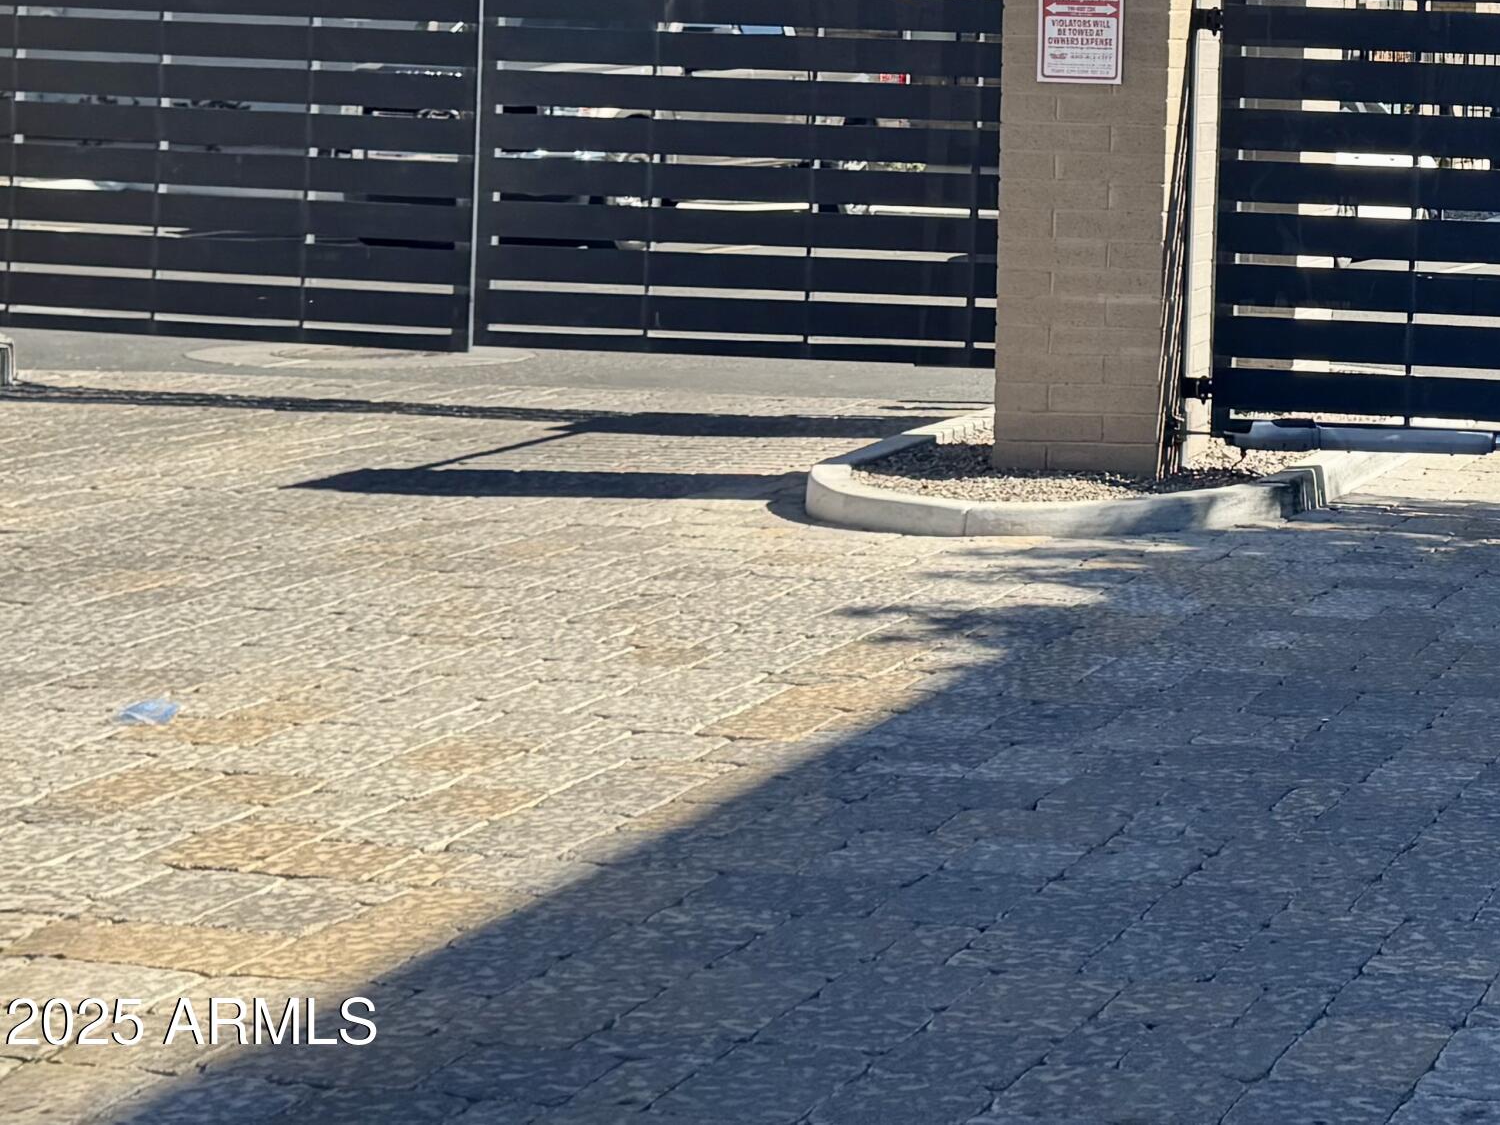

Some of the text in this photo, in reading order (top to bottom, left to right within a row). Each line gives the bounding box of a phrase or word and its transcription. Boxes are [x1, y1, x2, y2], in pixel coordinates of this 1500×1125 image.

[1051, 19, 1111, 28] VIOLATORS WILL
[1057, 28, 1104, 37] BE TOWED AT
[1048, 37, 1113, 46] OWNERS EXPENSE
